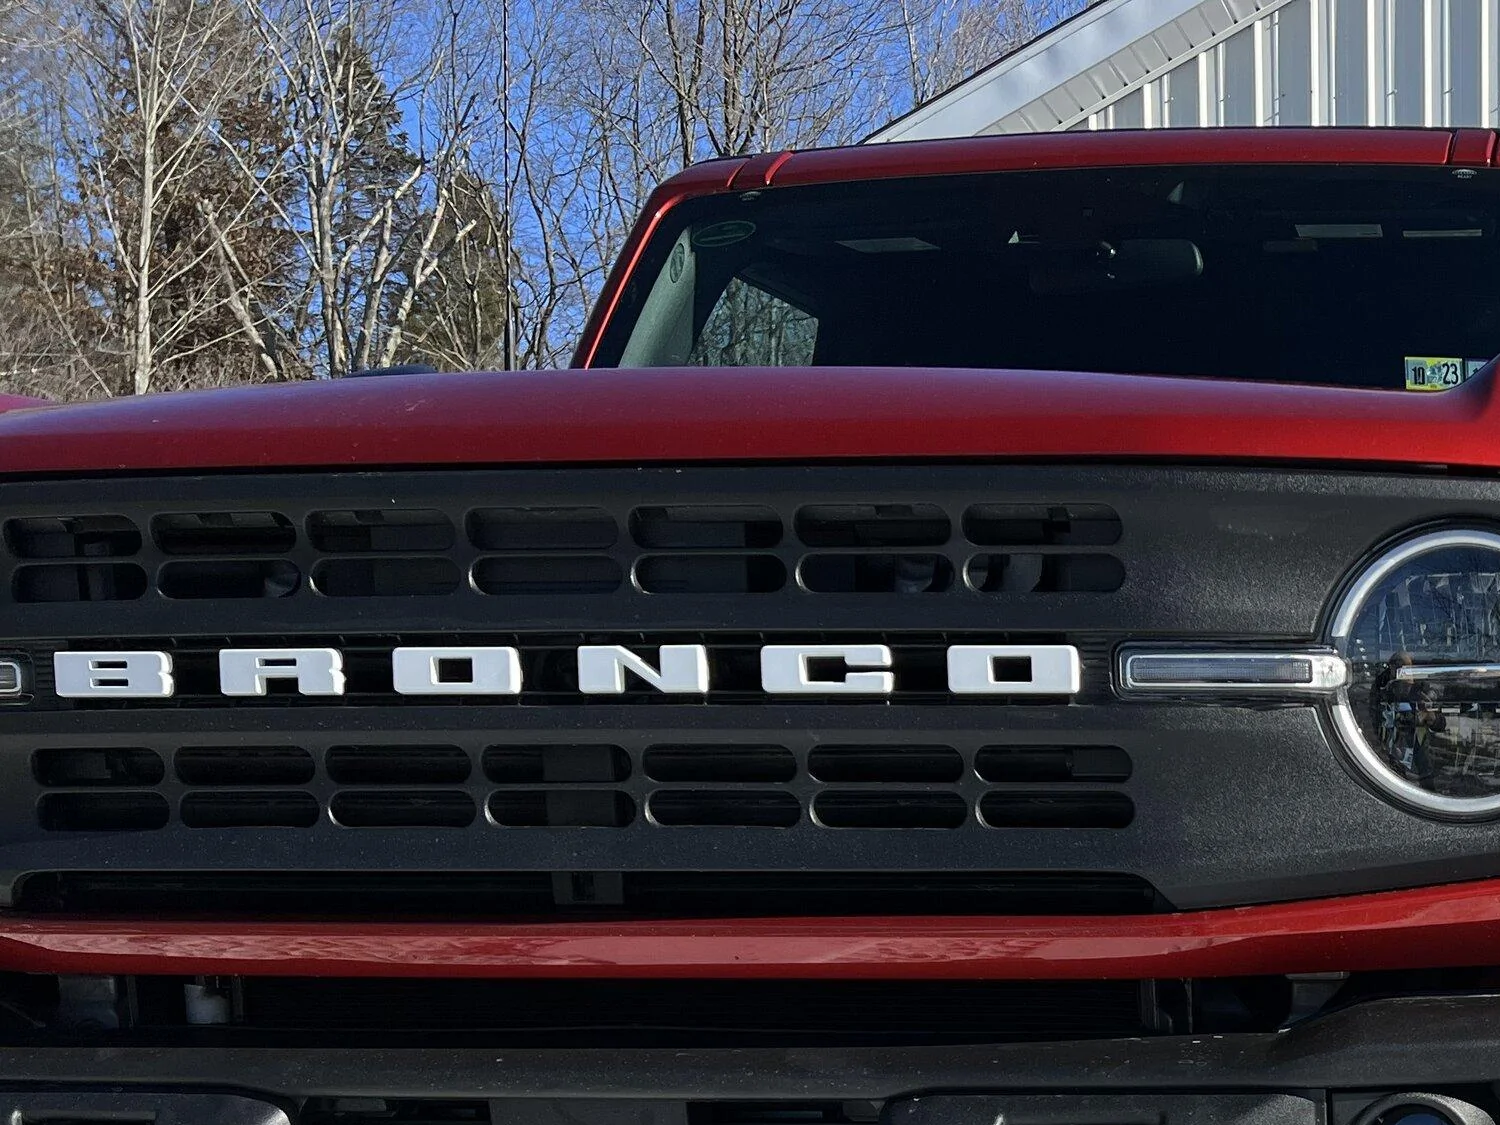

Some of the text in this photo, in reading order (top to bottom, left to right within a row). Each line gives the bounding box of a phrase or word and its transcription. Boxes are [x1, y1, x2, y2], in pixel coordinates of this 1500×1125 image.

[1412, 362, 1459, 385] 10 23
[53, 644, 1081, 697] BRONCO
